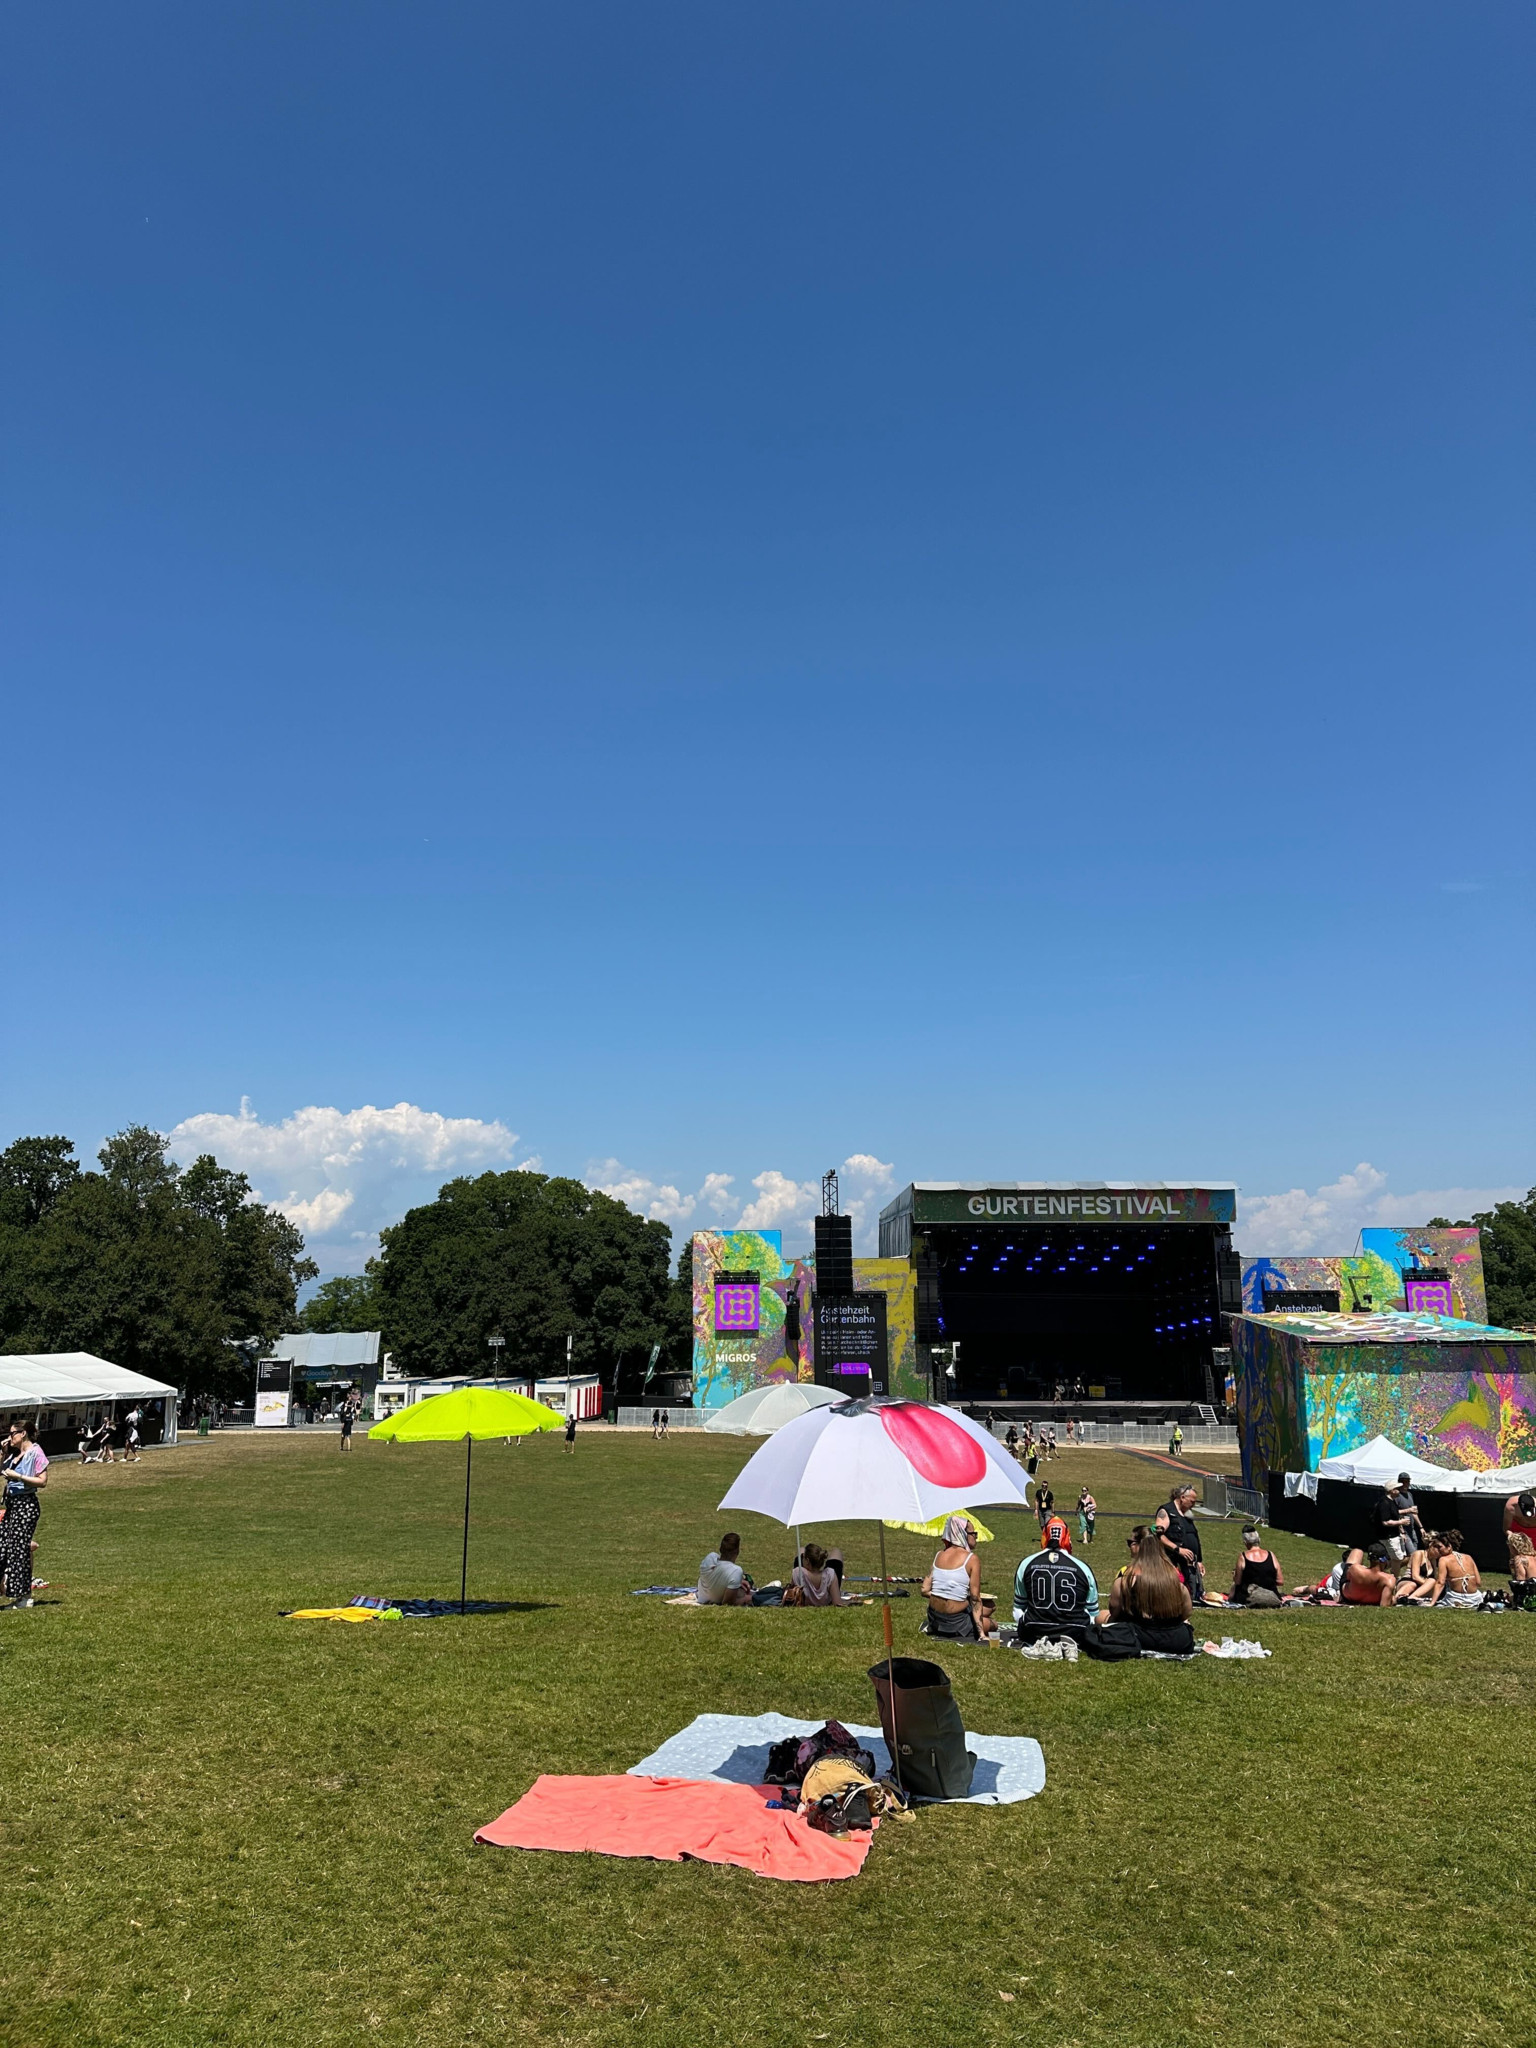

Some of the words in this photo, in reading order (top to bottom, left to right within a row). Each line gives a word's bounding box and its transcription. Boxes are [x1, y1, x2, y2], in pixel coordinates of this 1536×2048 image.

[967, 1195, 1181, 1215] GURTENFESTIVAL
[1274, 1303, 1324, 1313] Anstehzeit
[820, 1315, 876, 1324] Gurenbahn
[715, 1353, 757, 1363] MIGROS
[306, 1370, 333, 1378] Goodbye
[1031, 1568, 1077, 1611] 06
